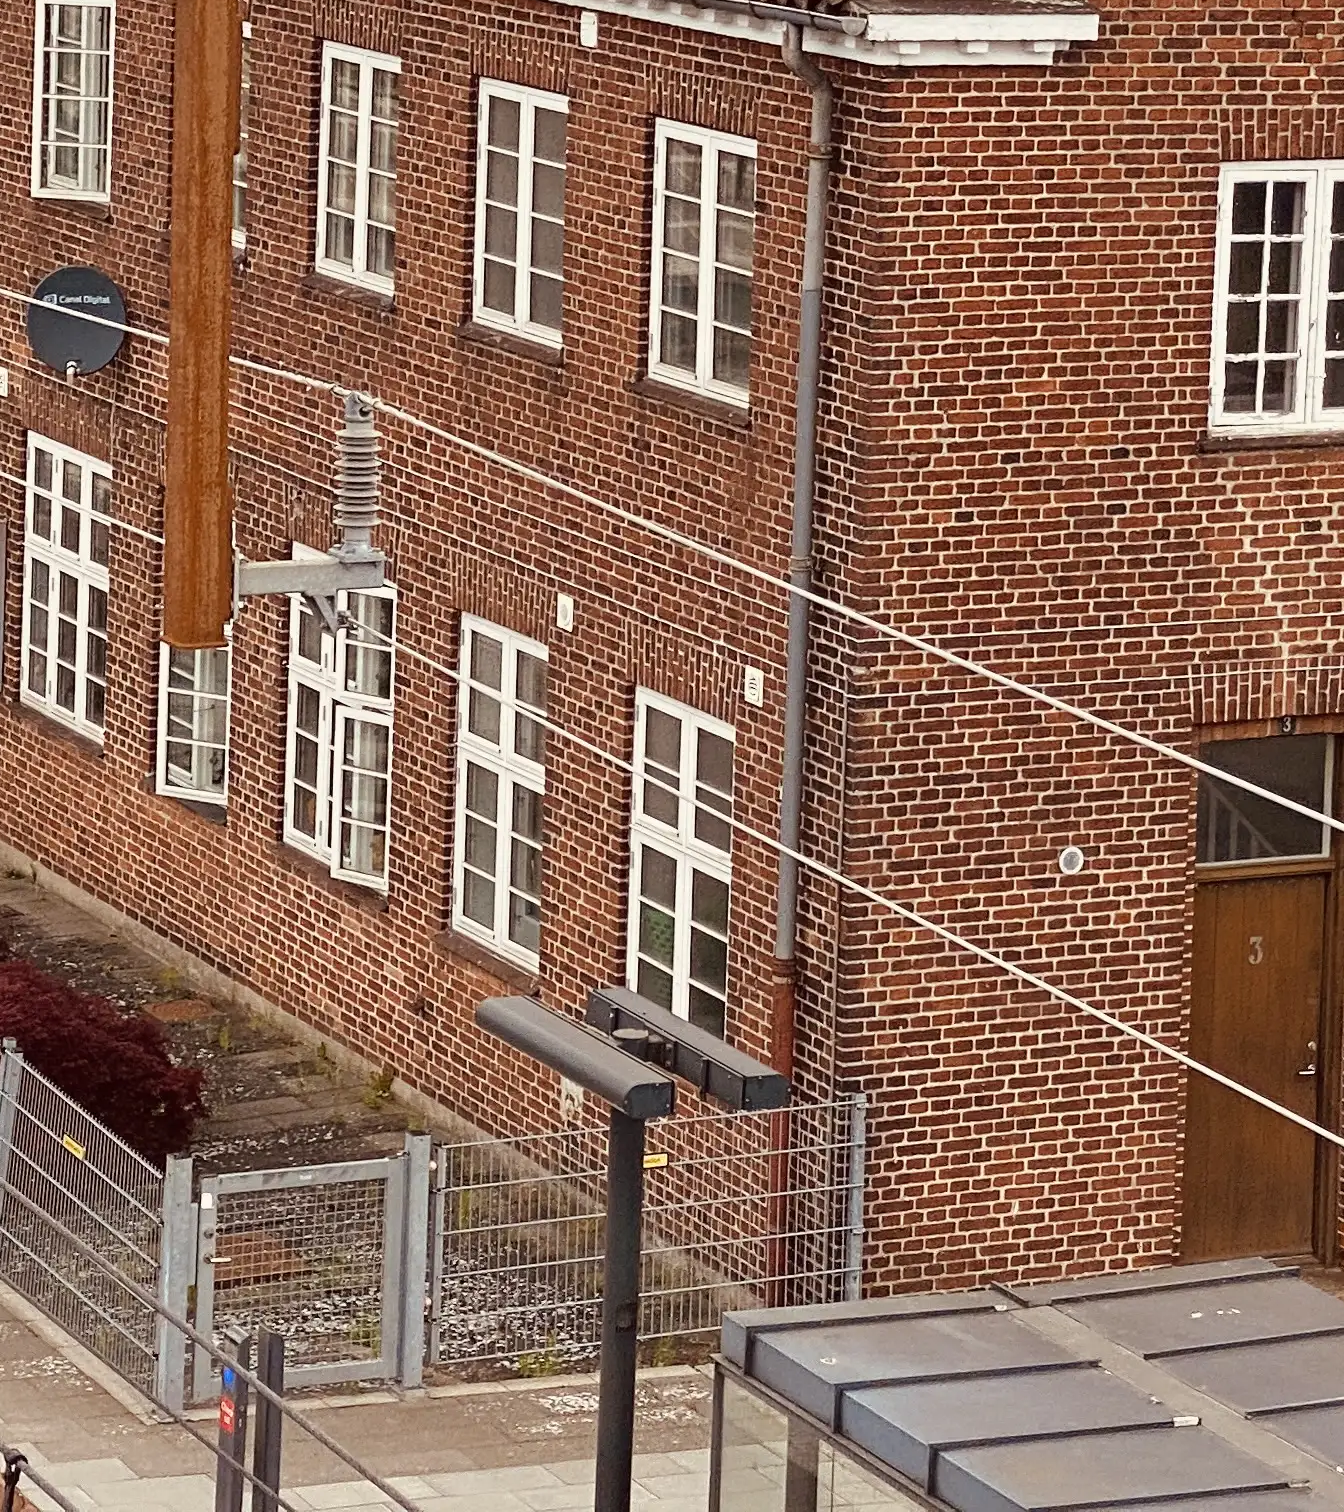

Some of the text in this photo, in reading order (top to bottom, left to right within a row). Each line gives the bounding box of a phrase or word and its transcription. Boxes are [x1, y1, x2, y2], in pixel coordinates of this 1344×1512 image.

[58, 295, 111, 305] Canal Digital
[1282, 716, 1292, 732] 3
[1248, 936, 1263, 965] 3
